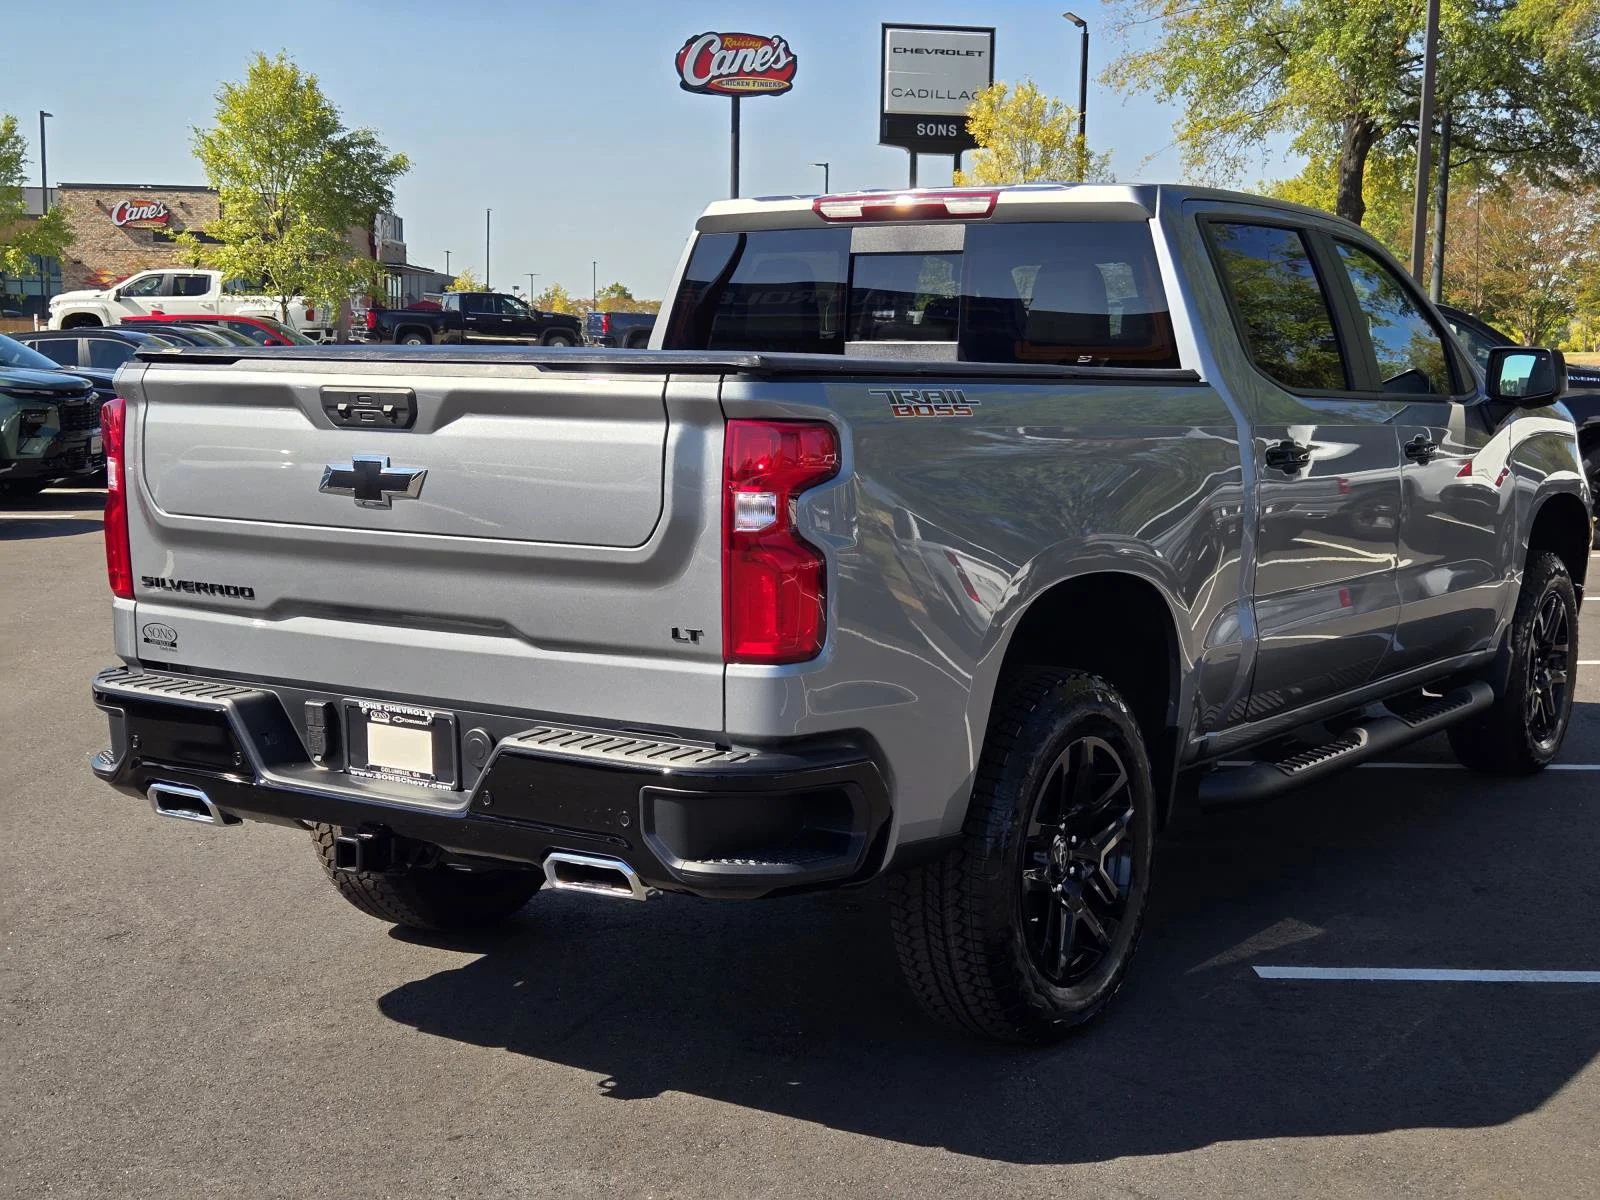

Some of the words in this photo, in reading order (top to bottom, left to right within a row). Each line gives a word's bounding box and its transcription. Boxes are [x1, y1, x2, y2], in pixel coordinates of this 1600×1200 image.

[723, 37, 762, 48] Raising
[683, 33, 794, 86] Cane's
[892, 47, 985, 57] CHEVROLET
[752, 80, 782, 88] FINGERS
[916, 123, 957, 137] SONS
[112, 200, 168, 226] Cane's
[868, 388, 981, 405] TRAIL
[890, 404, 974, 418] BOSS
[141, 575, 255, 600] SILVERADO
[146, 626, 173, 640] SONS
[671, 627, 704, 645] LT
[358, 701, 382, 711] SONS
[383, 704, 436, 718] CHEVROLET
